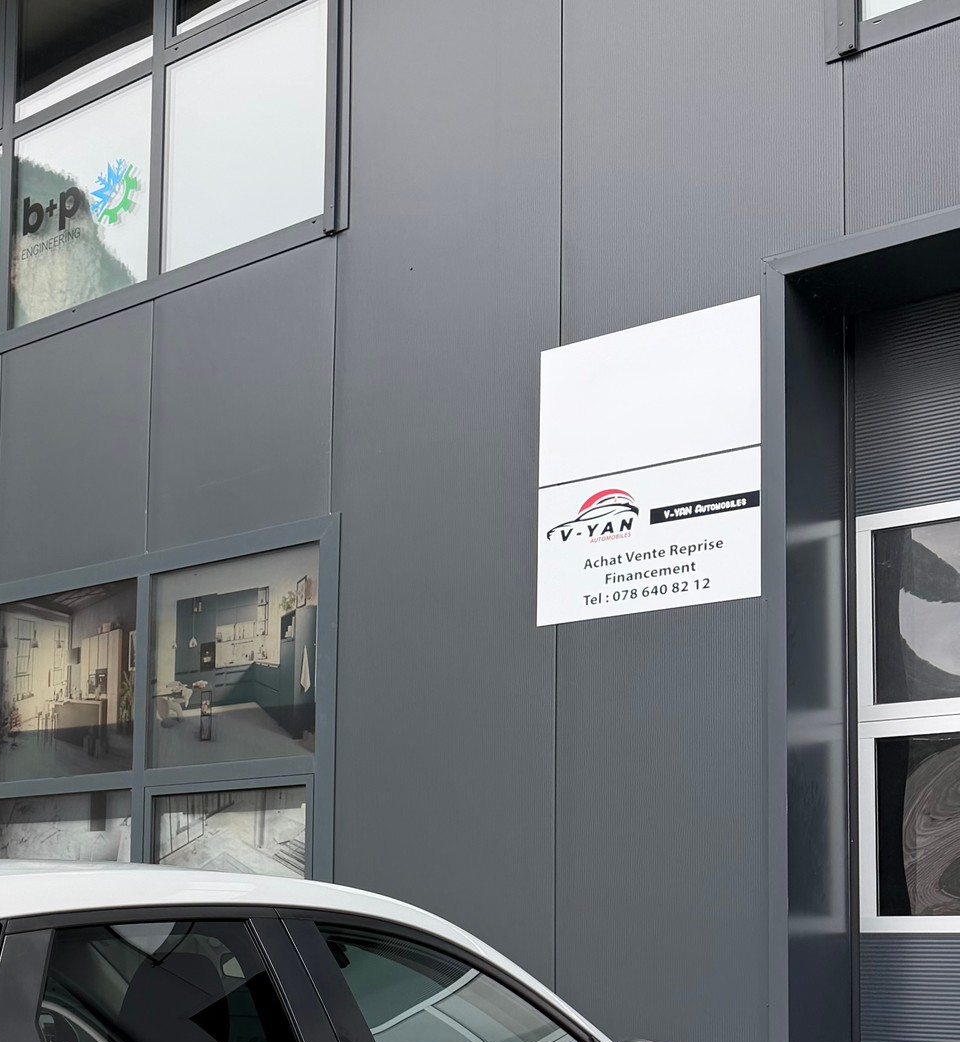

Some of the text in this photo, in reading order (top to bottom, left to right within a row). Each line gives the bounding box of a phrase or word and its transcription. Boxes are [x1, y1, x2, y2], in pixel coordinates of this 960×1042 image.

[21, 227, 81, 261] ENGINEERING
[663, 505, 693, 519] V-YAN
[560, 517, 634, 542] V-YAN
[589, 531, 632, 544] AUTOMOBILES
[583, 538, 724, 570] Achat Vente Reprise
[604, 561, 697, 585] Financement
[612, 588, 638, 602] 078
[641, 584, 668, 598] 640
[671, 580, 689, 593] 82
[693, 577, 711, 590] 12
